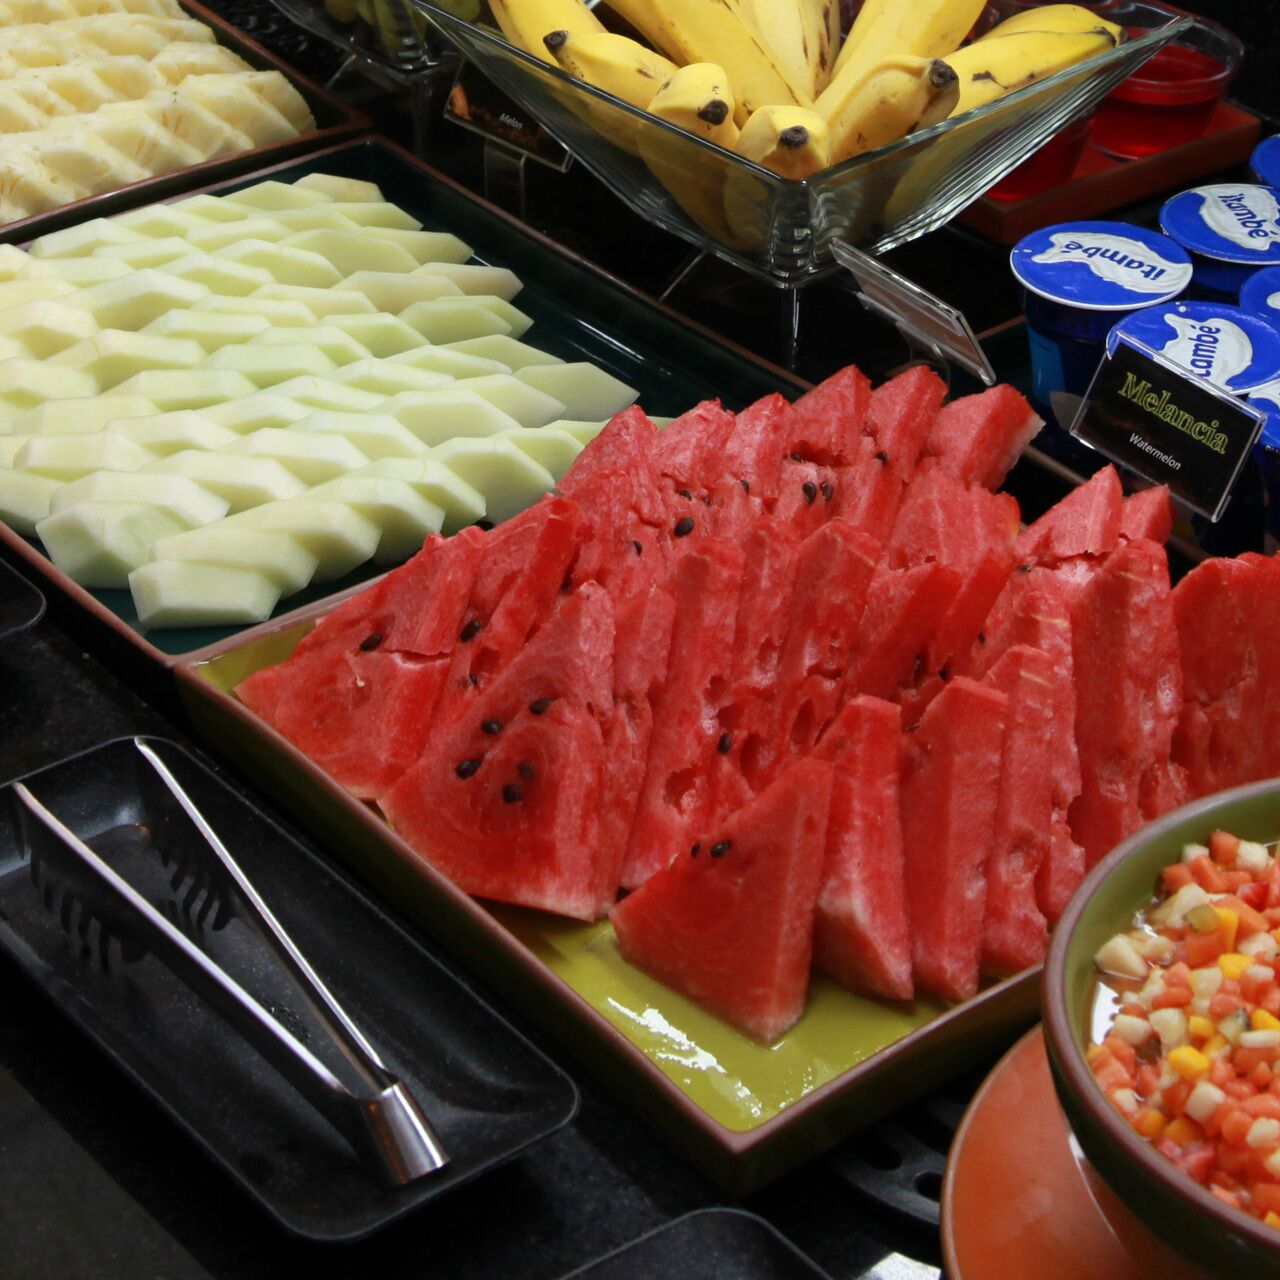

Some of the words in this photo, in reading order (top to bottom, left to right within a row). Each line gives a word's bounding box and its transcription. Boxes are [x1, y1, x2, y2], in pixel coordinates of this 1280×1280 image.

[498, 112, 524, 130] Melon
[1218, 192, 1275, 239] itambé
[1063, 239, 1168, 282] itambé
[1188, 324, 1221, 378] ambé
[1117, 370, 1229, 456] Melancia
[1128, 432, 1182, 472] Watermelon
